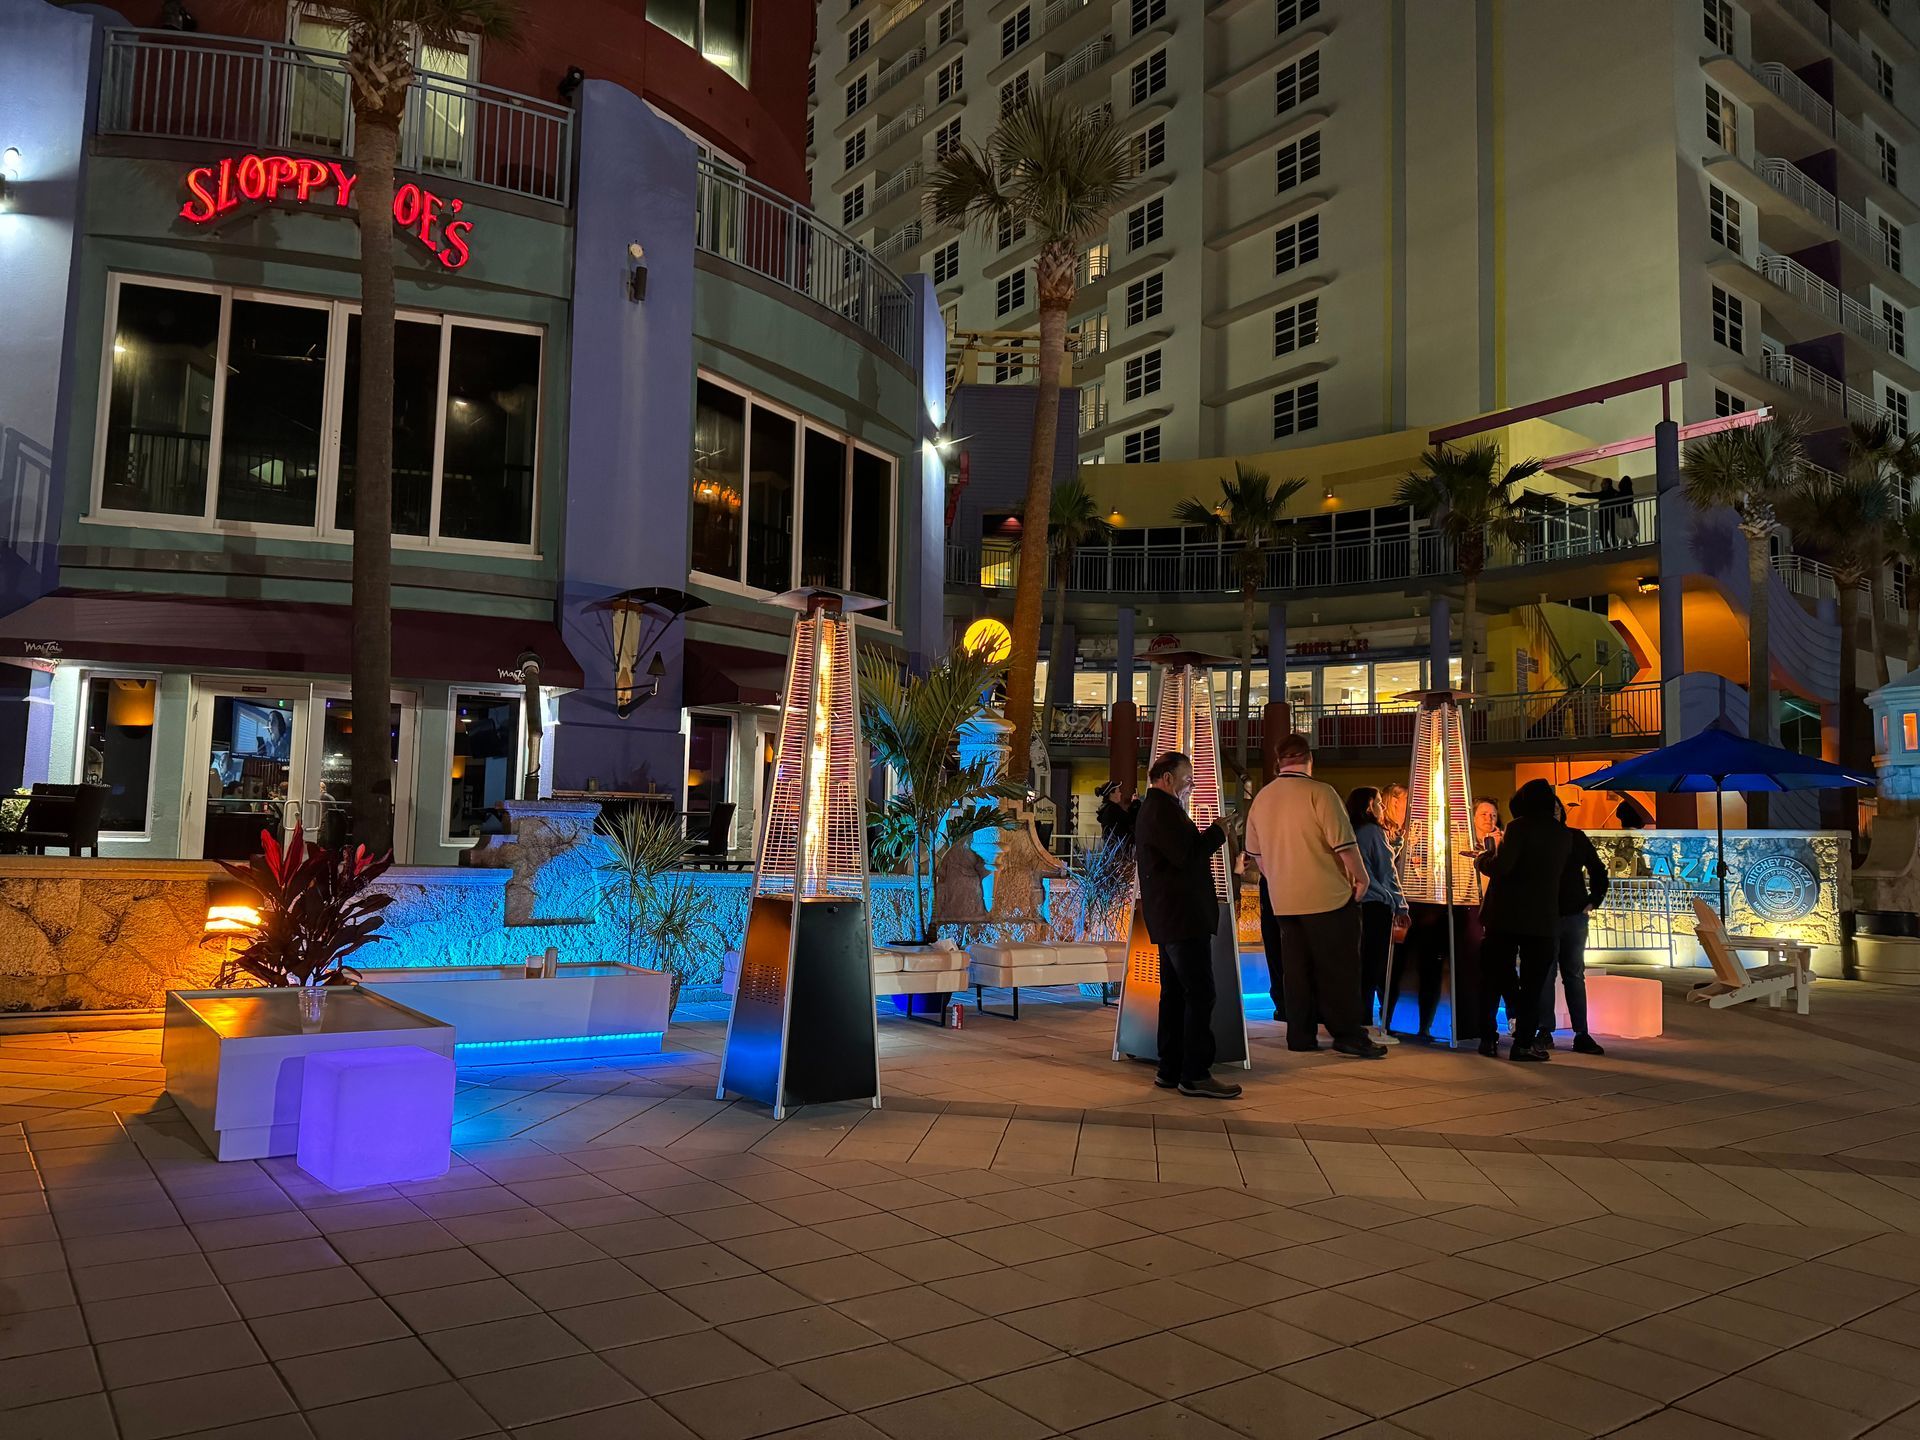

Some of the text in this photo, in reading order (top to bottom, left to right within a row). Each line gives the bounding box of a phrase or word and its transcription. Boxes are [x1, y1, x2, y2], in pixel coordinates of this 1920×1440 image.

[179, 153, 474, 269] SLOPPY OE'S
[1609, 857, 1719, 883] PLAZA
[1747, 858, 1813, 887] RITCHEY PLAZA
[1753, 901, 1771, 916] MAYOR
